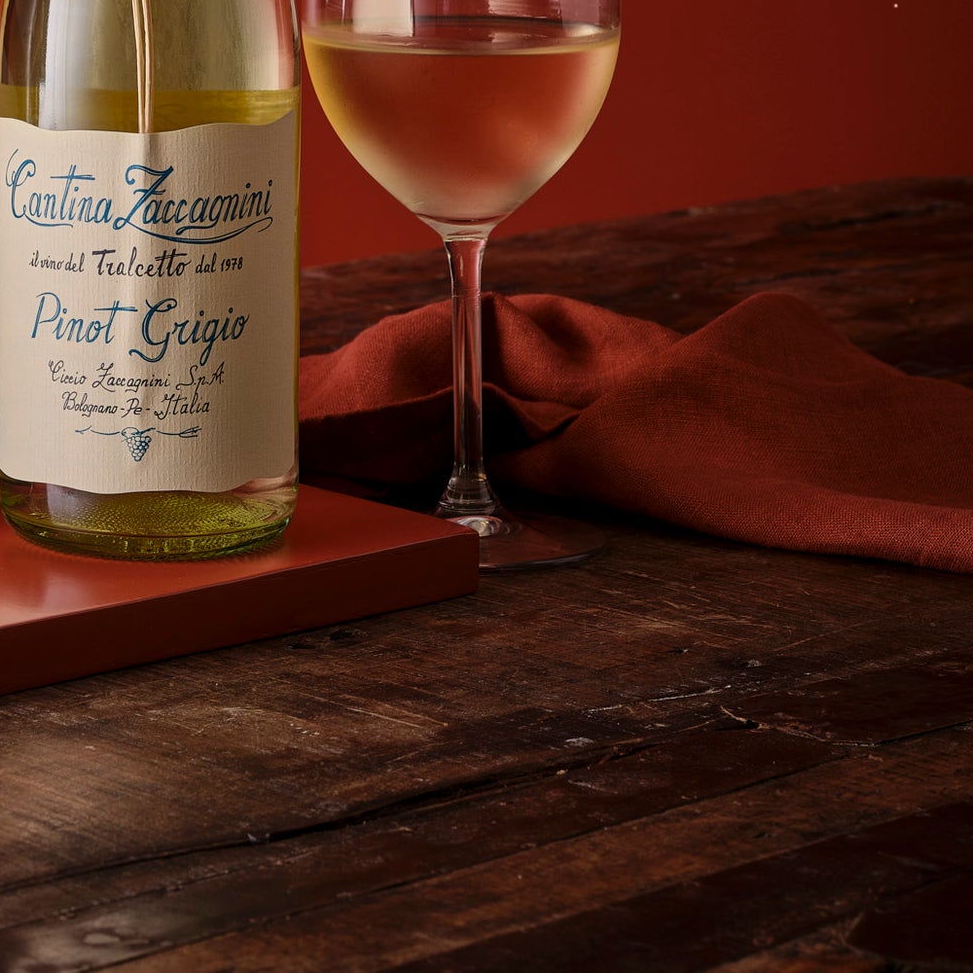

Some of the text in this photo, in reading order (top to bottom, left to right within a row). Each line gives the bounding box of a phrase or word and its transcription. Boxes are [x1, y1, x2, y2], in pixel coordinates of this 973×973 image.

[6, 148, 274, 245] Cantina Zaccagnini
[91, 247, 192, 278] Tralcetto
[195, 252, 216, 274] dal
[220, 256, 244, 273] 1978
[30, 292, 251, 367] Pinot Grigio
[92, 362, 171, 393] Zaccagnini
